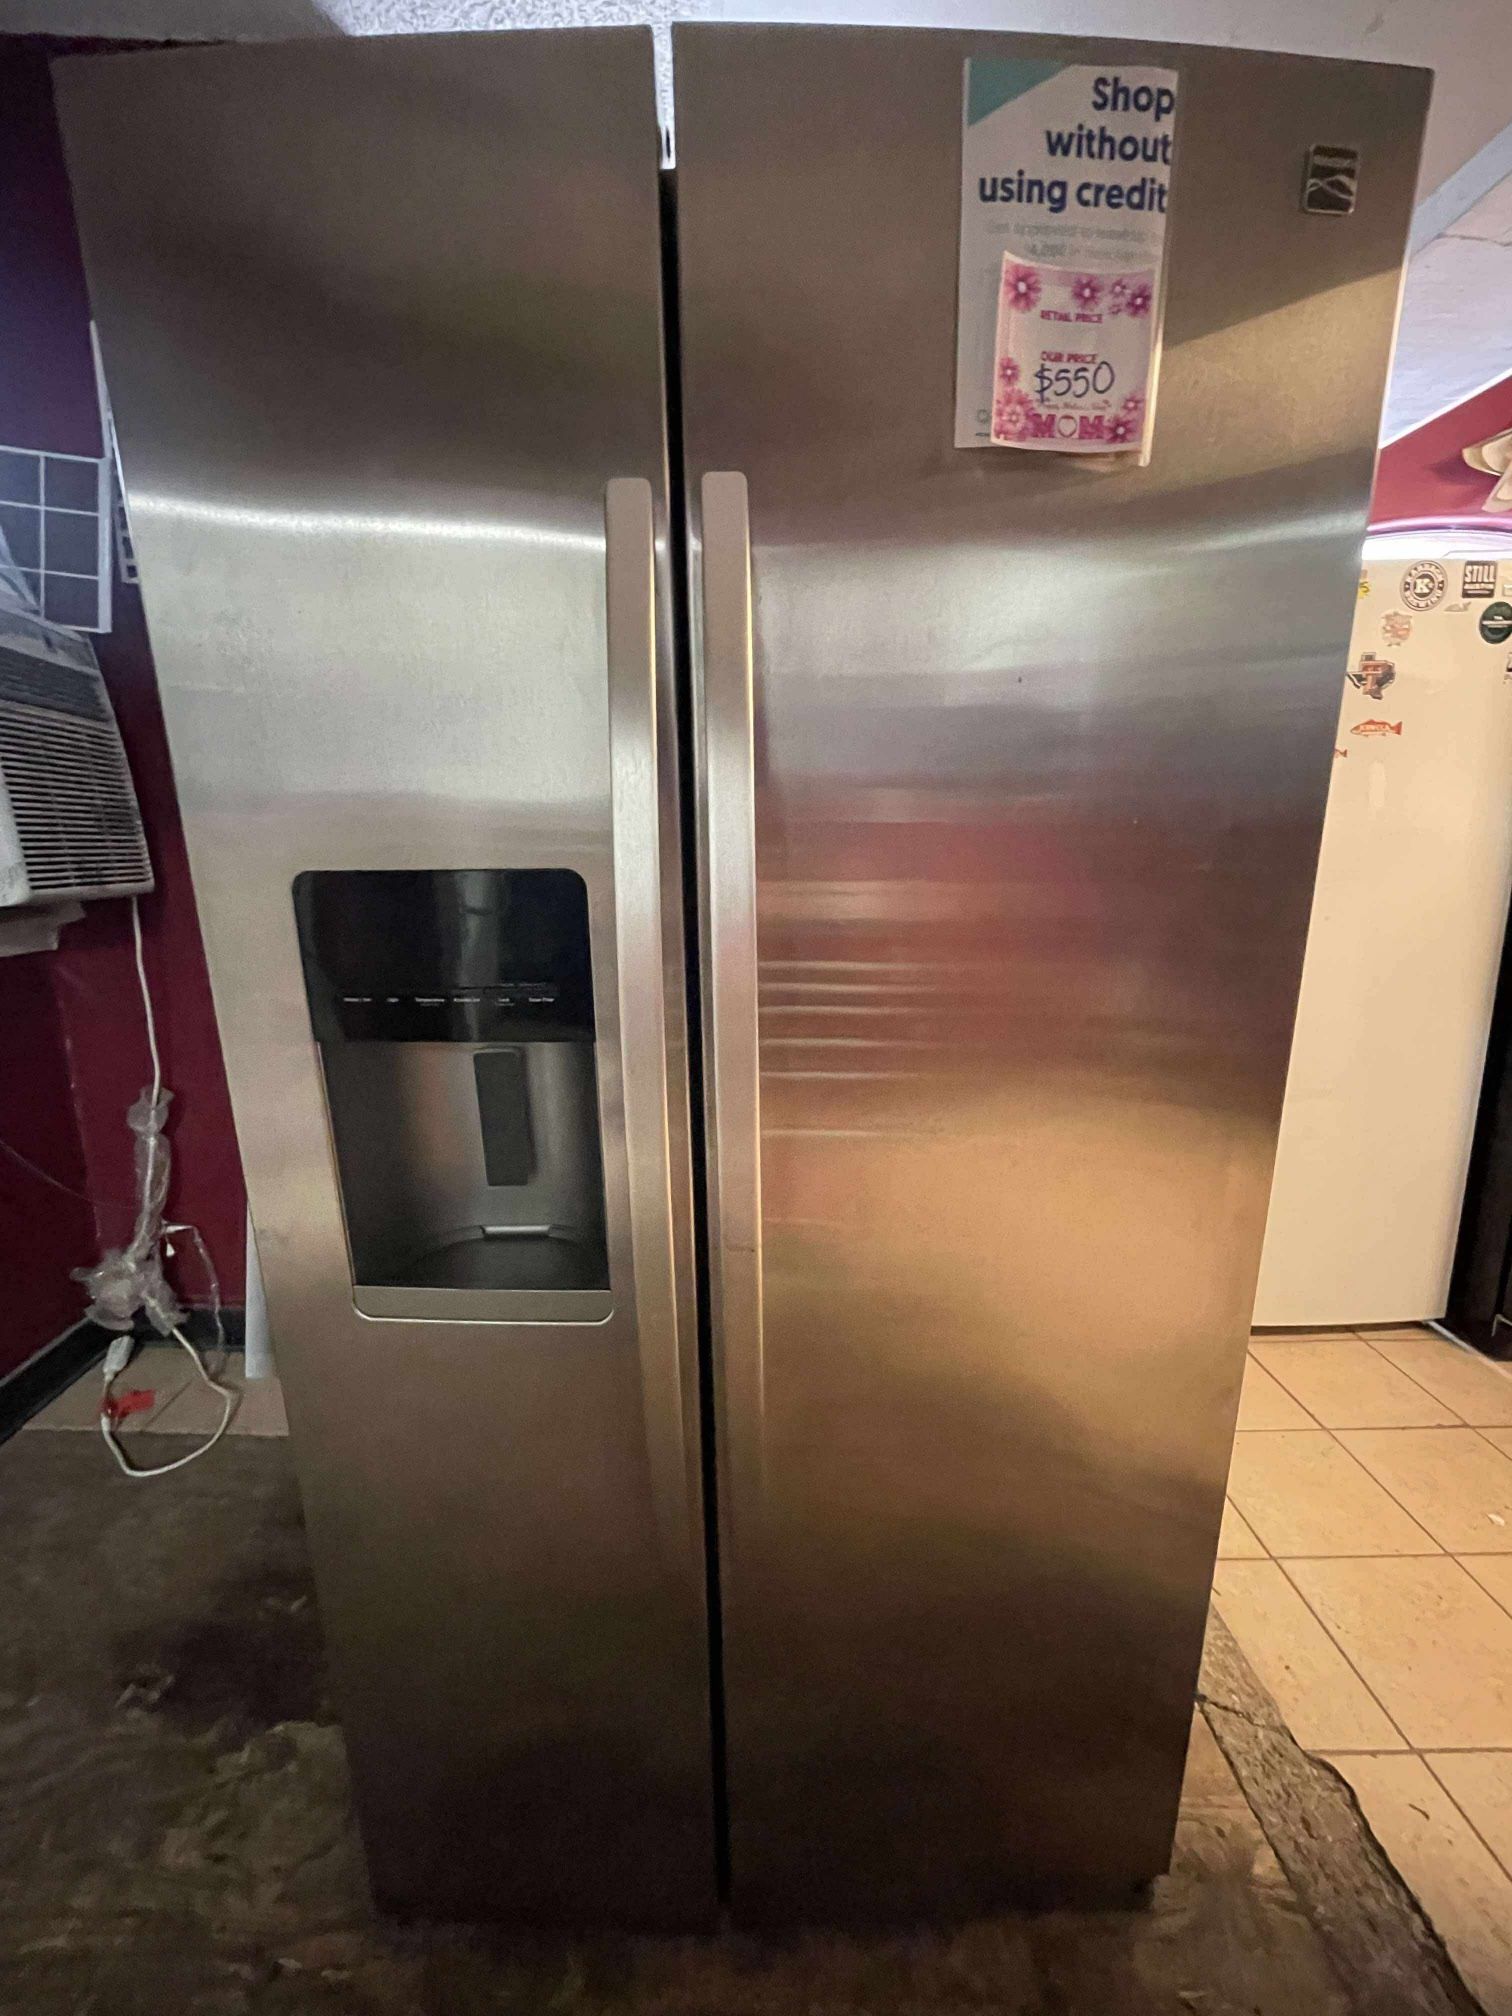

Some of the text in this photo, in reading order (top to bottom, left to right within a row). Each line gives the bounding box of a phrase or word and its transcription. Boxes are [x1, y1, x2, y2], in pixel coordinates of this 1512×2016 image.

[1091, 76, 1176, 122] Shop
[1046, 123, 1172, 166] without
[979, 169, 1168, 214] using credit
[1040, 309, 1104, 324] RETAIL PRICE
[1040, 350, 1099, 364] OUR PRICE
[1033, 361, 1115, 404] $550
[1464, 565, 1497, 582] STILL
